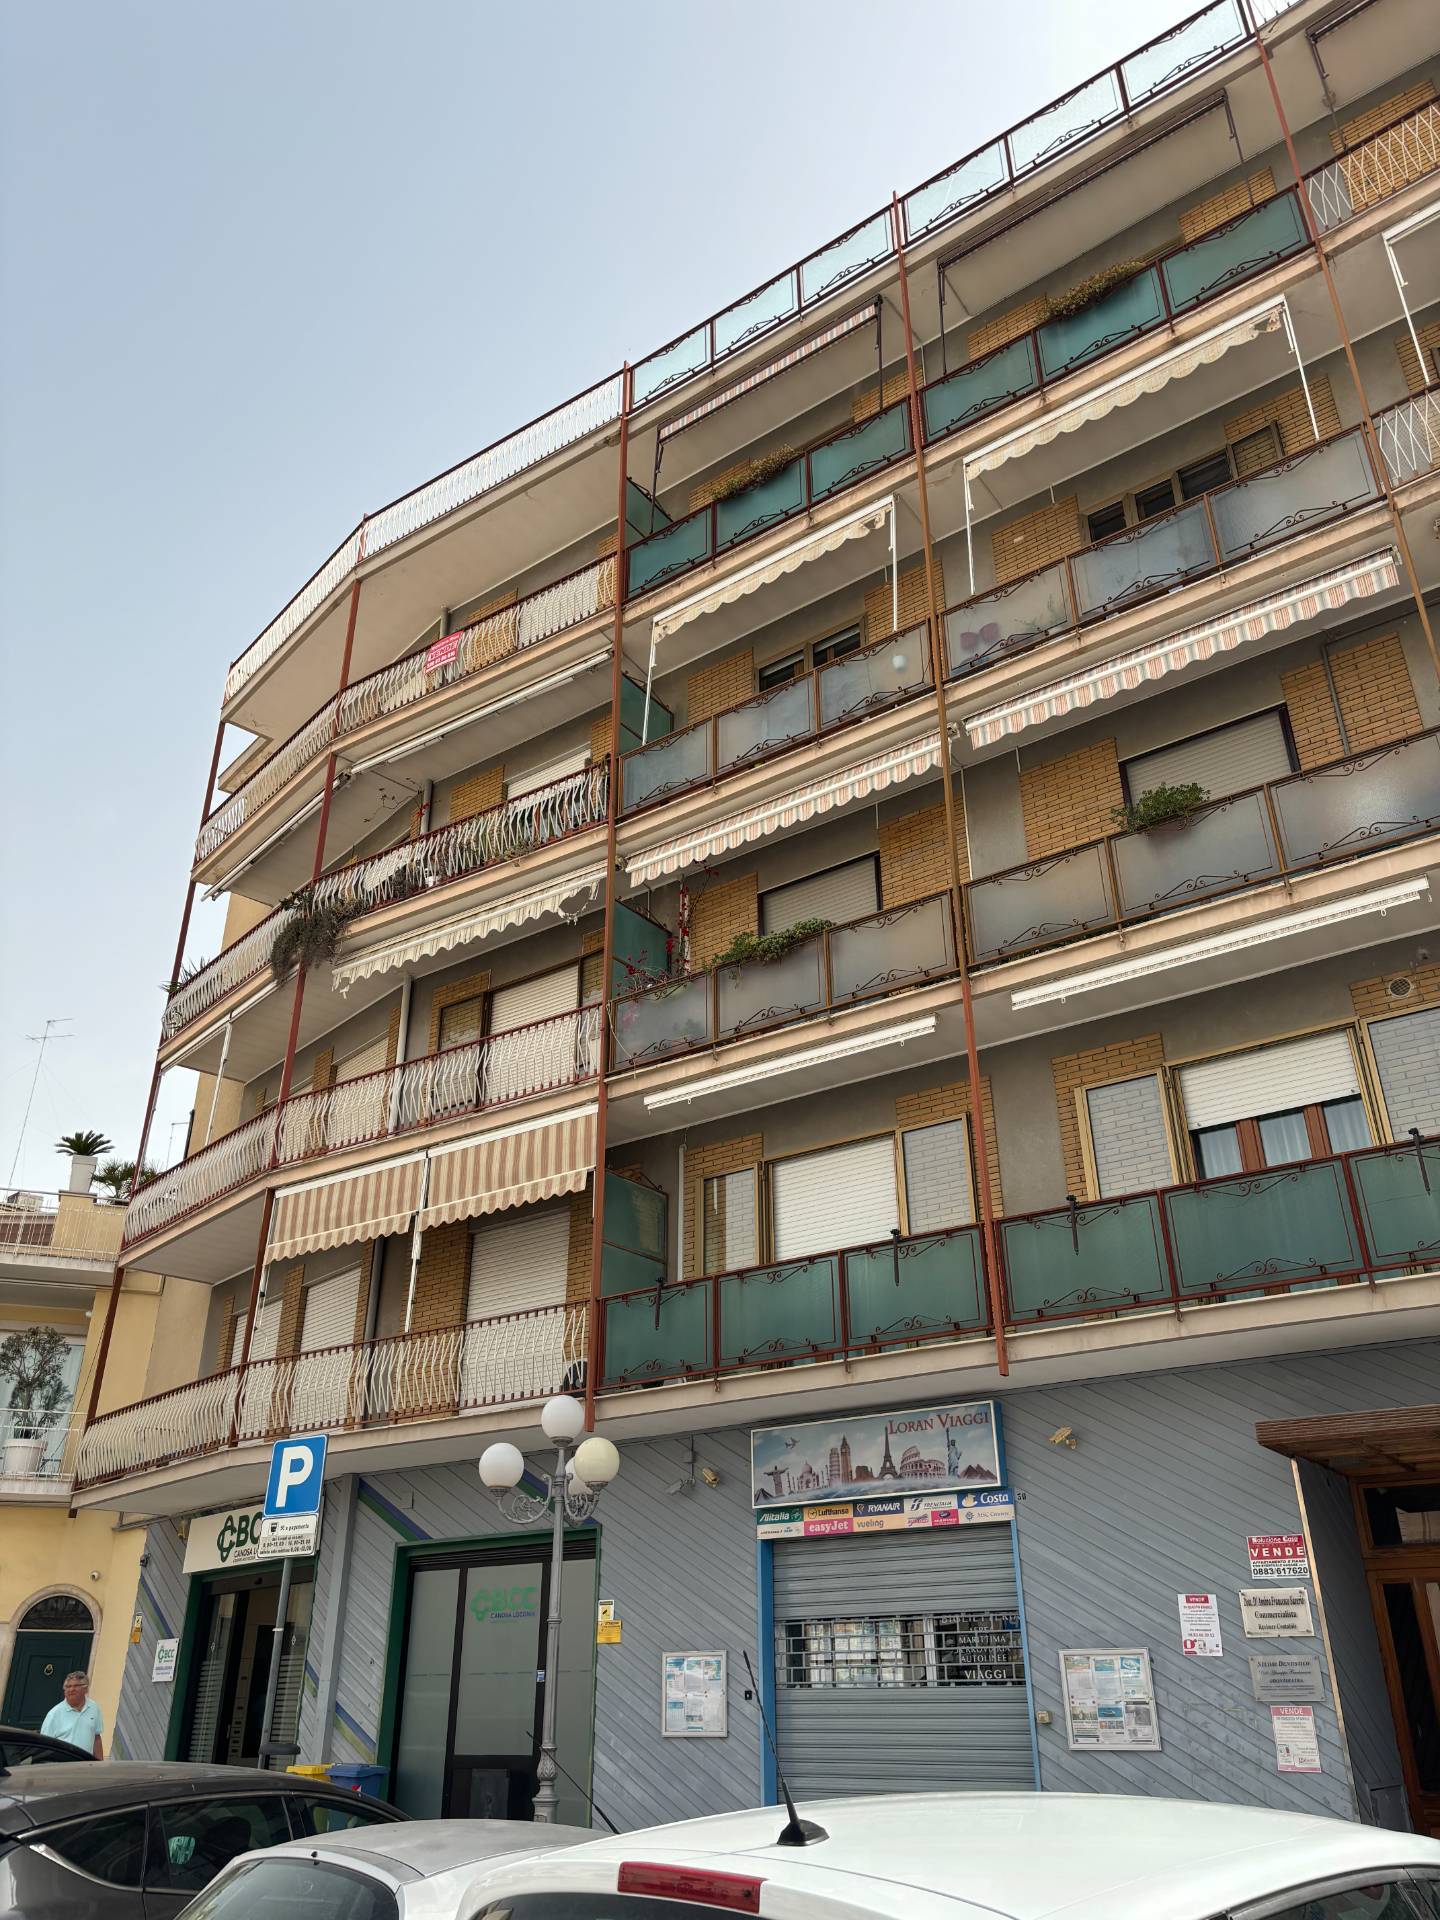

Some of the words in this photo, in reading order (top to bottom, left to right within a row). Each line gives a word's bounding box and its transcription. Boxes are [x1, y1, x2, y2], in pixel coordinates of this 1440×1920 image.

[888, 1419, 934, 1435] LORAN
[936, 1412, 990, 1428] VIAGGI
[275, 1445, 314, 1509] P
[980, 1492, 1009, 1504] Costa
[867, 1501, 901, 1513] RYANAIR
[923, 1500, 952, 1508] TRENITALIA
[759, 1511, 790, 1522] Alitalia
[817, 1507, 849, 1517] Lufthansa
[809, 1519, 849, 1533] easyJet
[856, 1518, 885, 1529] vueling
[233, 1548, 253, 1558] CANOSA
[1251, 1546, 1305, 1557] VENDE
[1255, 1610, 1298, 1619] Commercialista
[959, 1635, 1007, 1644] MARTTIMA
[964, 1669, 1007, 1680] VIAGGI
[1280, 1707, 1304, 1715] VENDE
